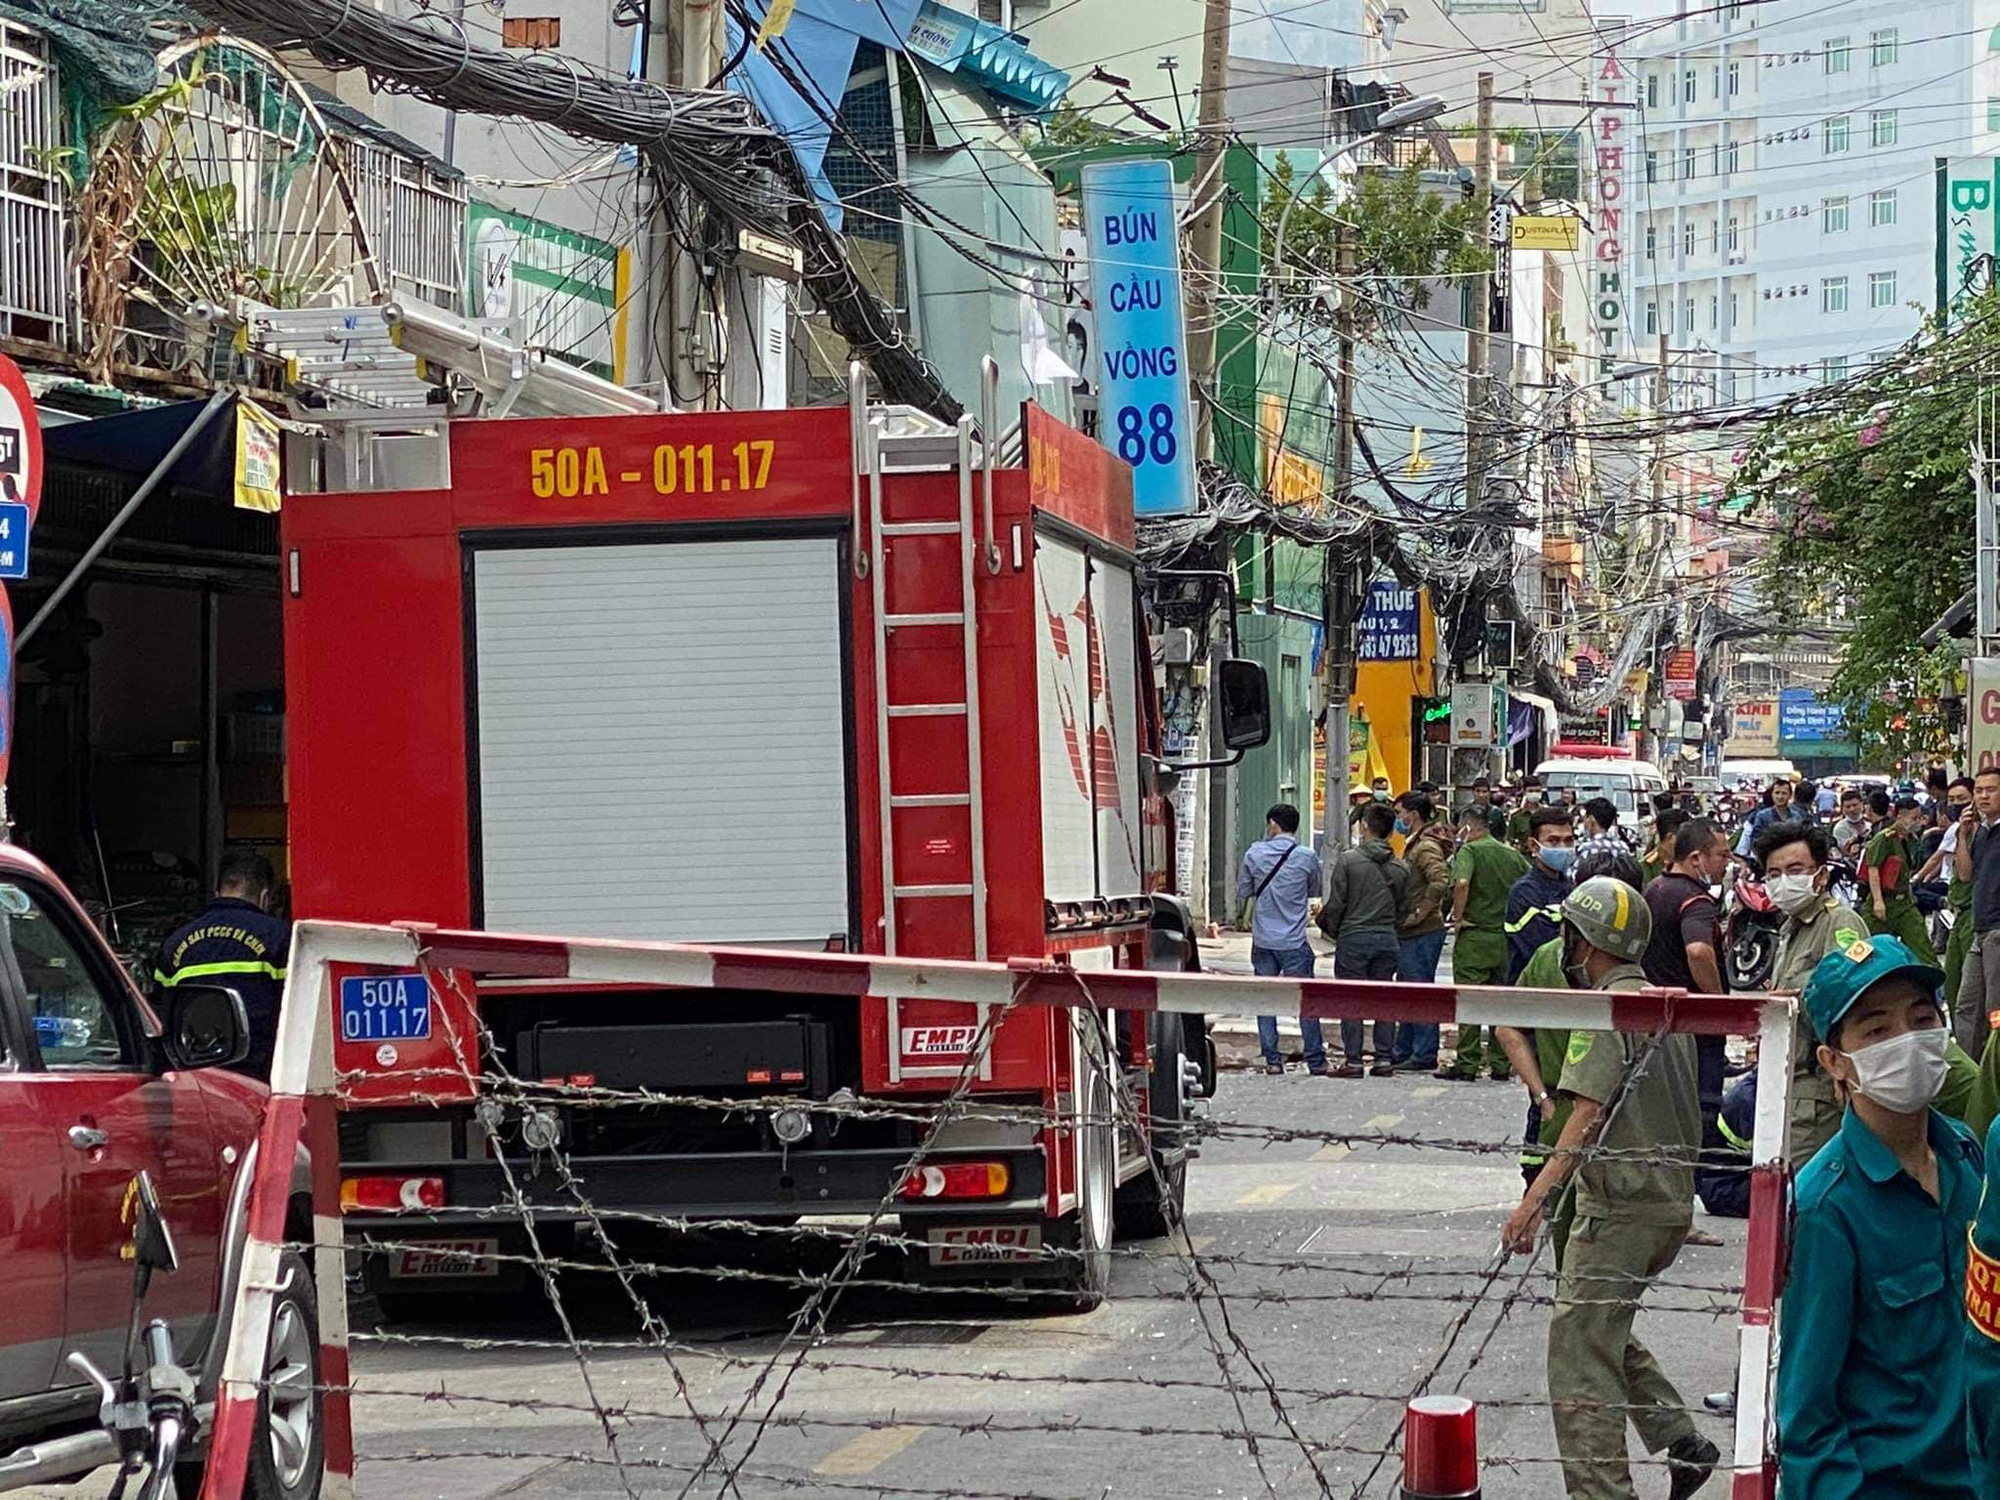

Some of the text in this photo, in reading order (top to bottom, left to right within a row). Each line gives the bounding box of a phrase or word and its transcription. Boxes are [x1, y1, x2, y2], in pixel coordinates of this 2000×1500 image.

[1104, 205, 1156, 245] BÚN
[1117, 403, 1177, 467] 88
[531, 446, 609, 498] 50A
[653, 440, 775, 495] 011.17
[1390, 617, 1400, 630] 2
[362, 979, 408, 1007] 50A
[345, 1007, 427, 1037] 011.17
